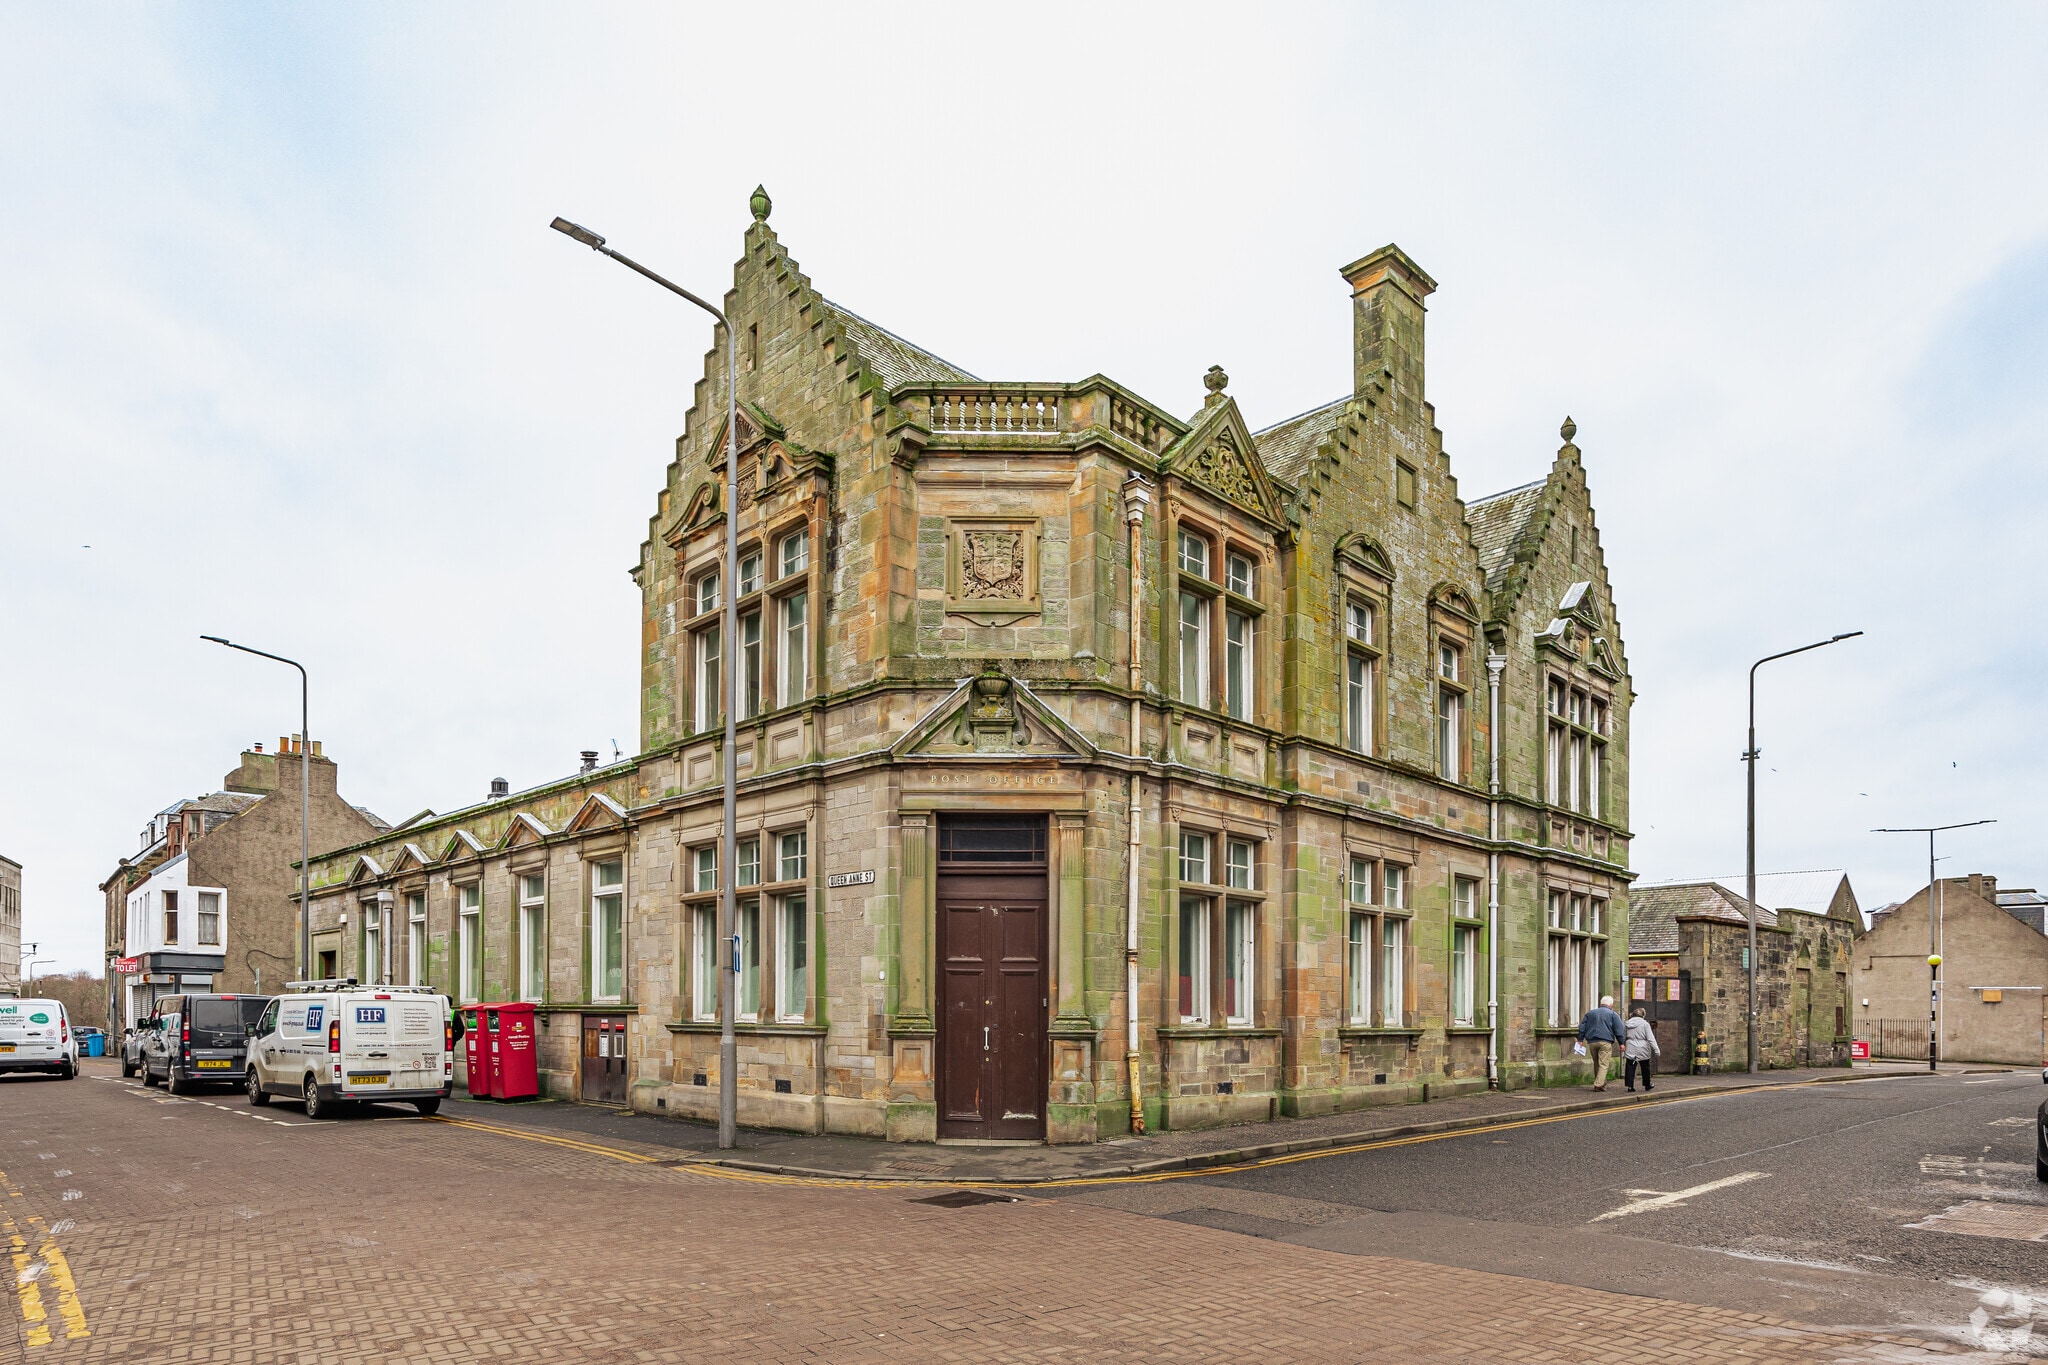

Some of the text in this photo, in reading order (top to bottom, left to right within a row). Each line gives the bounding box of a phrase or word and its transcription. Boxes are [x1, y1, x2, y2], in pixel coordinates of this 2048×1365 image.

[989, 775, 1055, 785] OFFICE
[831, 872, 873, 886] QUEEN ANNE ST
[115, 964, 137, 972] TO LET
[308, 1010, 322, 1027] HF
[359, 1009, 383, 1022] HF
